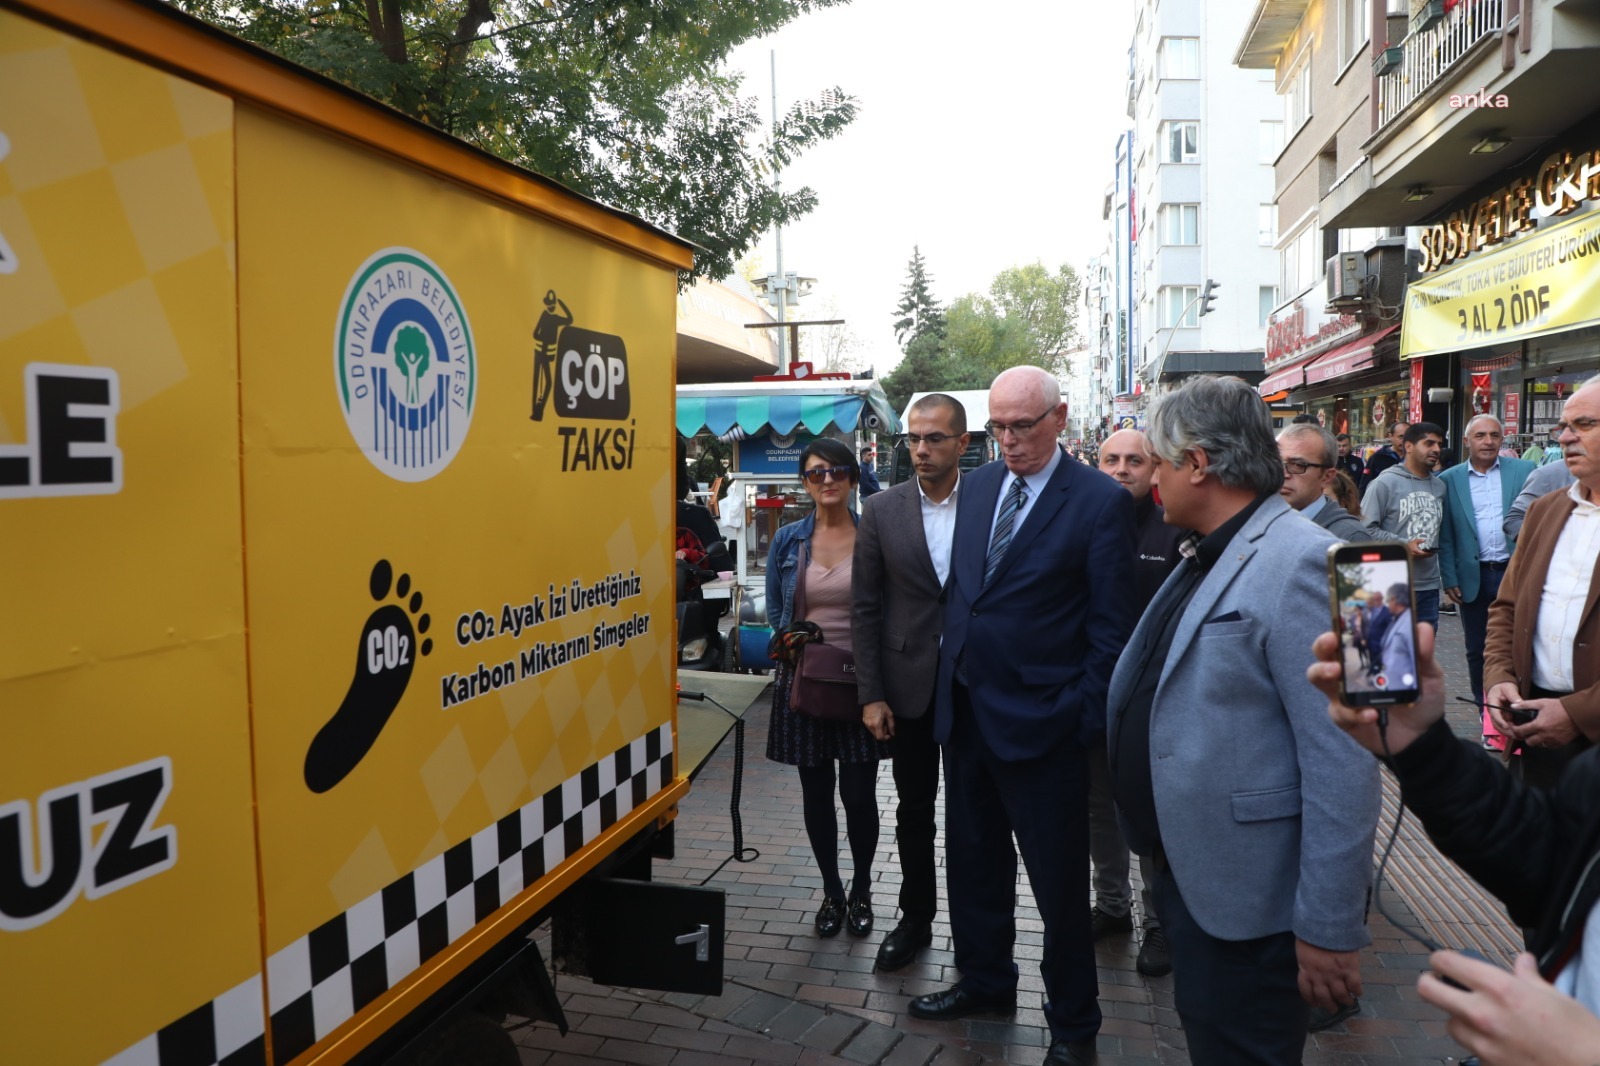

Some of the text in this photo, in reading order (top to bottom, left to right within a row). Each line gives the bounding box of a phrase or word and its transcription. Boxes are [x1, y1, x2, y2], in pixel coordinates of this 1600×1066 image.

[1418, 178, 1529, 273] SOSYETE
[1467, 268, 1490, 293] TOKA
[1493, 262, 1506, 284] VE
[1508, 238, 1555, 280] BİJUTERİ
[1558, 227, 1600, 264] ÜRÜN
[350, 269, 467, 410] ODUNPAZARI BELEDİYESİ
[1457, 285, 1550, 342] 3 AL 2 ÖDE
[561, 344, 625, 409] ÇÖP
[557, 419, 636, 472] TAKSİ
[457, 569, 642, 646] CO2 Ayak İzi Ürettiğiniz
[367, 625, 409, 675] CO2
[442, 611, 650, 709] Karbon Miktarını Simgeler
